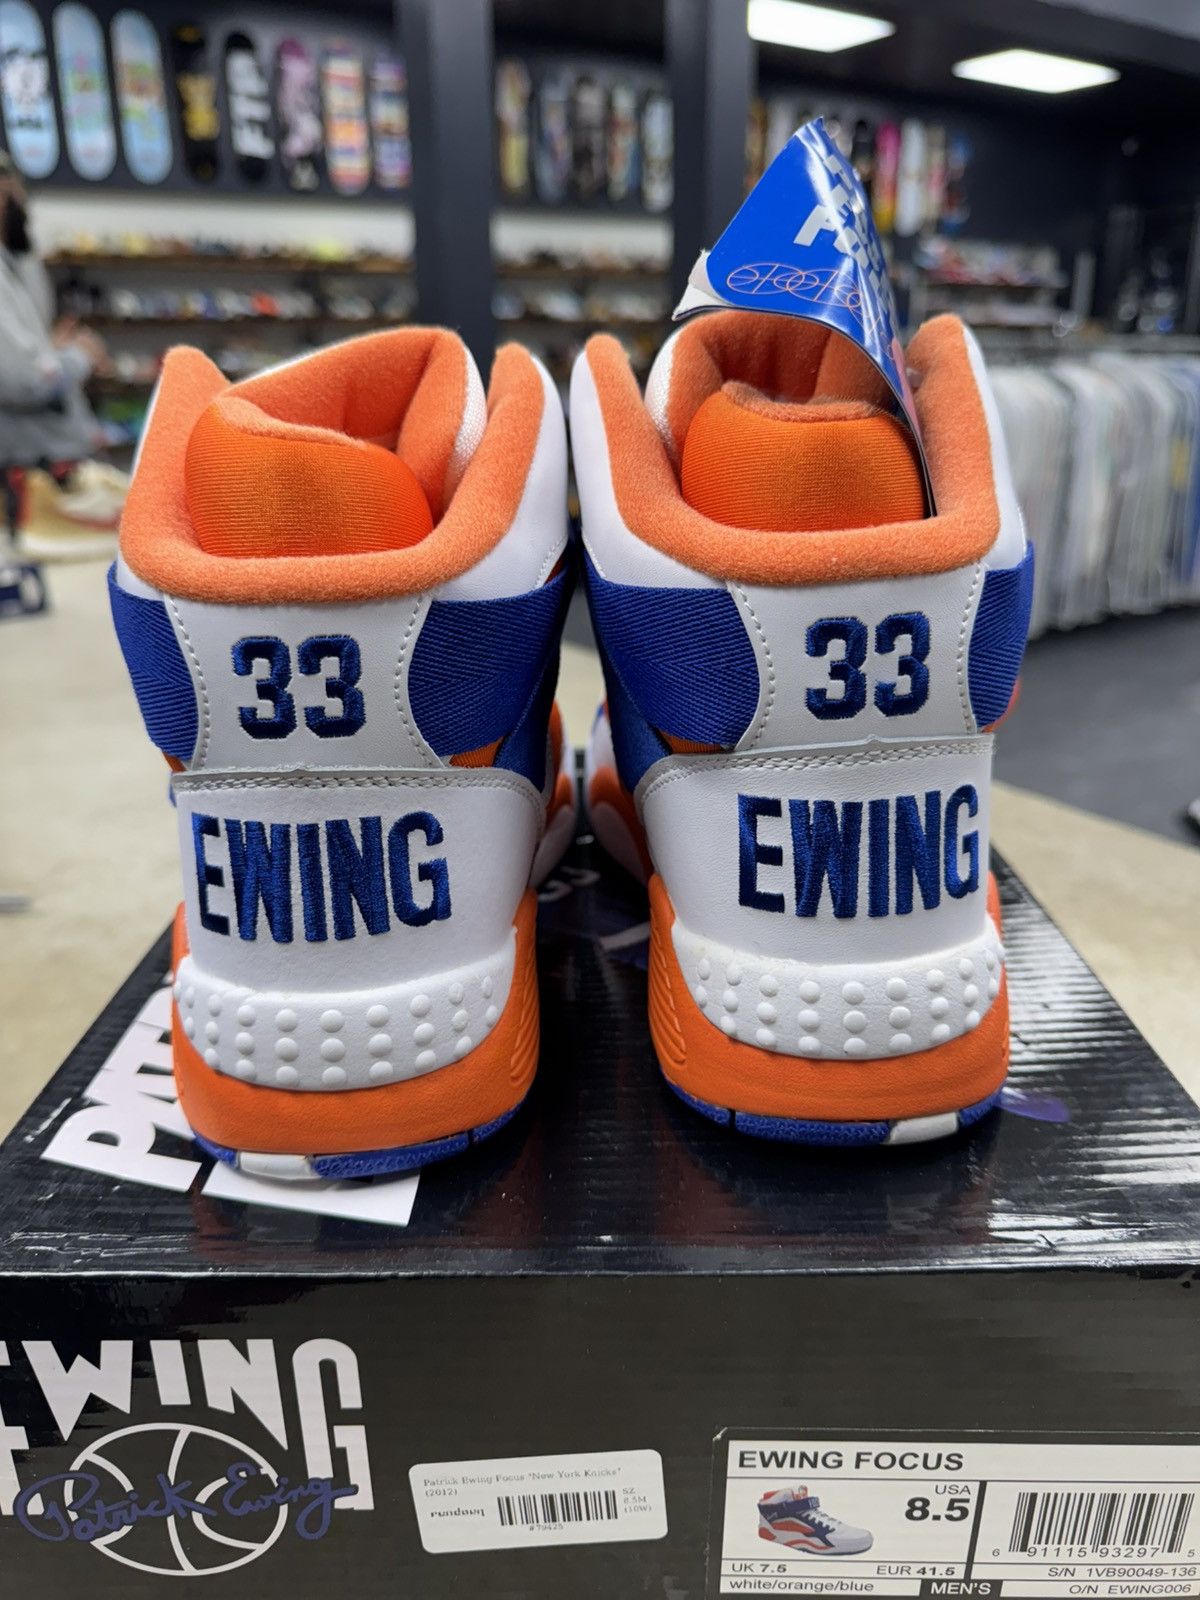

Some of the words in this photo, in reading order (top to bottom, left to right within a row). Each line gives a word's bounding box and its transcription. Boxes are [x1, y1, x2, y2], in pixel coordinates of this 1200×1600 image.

[805, 612, 930, 720] 33
[231, 634, 366, 739] 33
[738, 784, 979, 919] EWING
[191, 811, 451, 943] EWING
[738, 1450, 843, 1469] EWING
[854, 1452, 963, 1471] FOCUS
[423, 1477, 459, 1487] Patrick
[462, 1475, 493, 1485] Ewing
[495, 1474, 525, 1482] Focus
[557, 1470, 581, 1479] York
[425, 1488, 458, 1497] (2012)
[935, 1485, 971, 1496] USA
[13, 1473, 218, 1542] Patrick
[223, 1462, 358, 1540] Ewing
[905, 1496, 971, 1522] 8.5
[992, 1548, 1001, 1557] 6
[1027, 1547, 1087, 1558] 91115
[1099, 1547, 1160, 1558] 93297
[1187, 1549, 1195, 1558] 5
[731, 1563, 754, 1573] UK
[760, 1563, 787, 1574] 7.5
[876, 1565, 911, 1576] EUR
[916, 1567, 956, 1577] 41.5
[1048, 1567, 1076, 1578] S/N
[729, 1578, 874, 1594] white/orange/blue
[930, 1582, 991, 1596] MEN'S
[1069, 1584, 1099, 1595] O/N
[1108, 1583, 1192, 1595] EWING006
